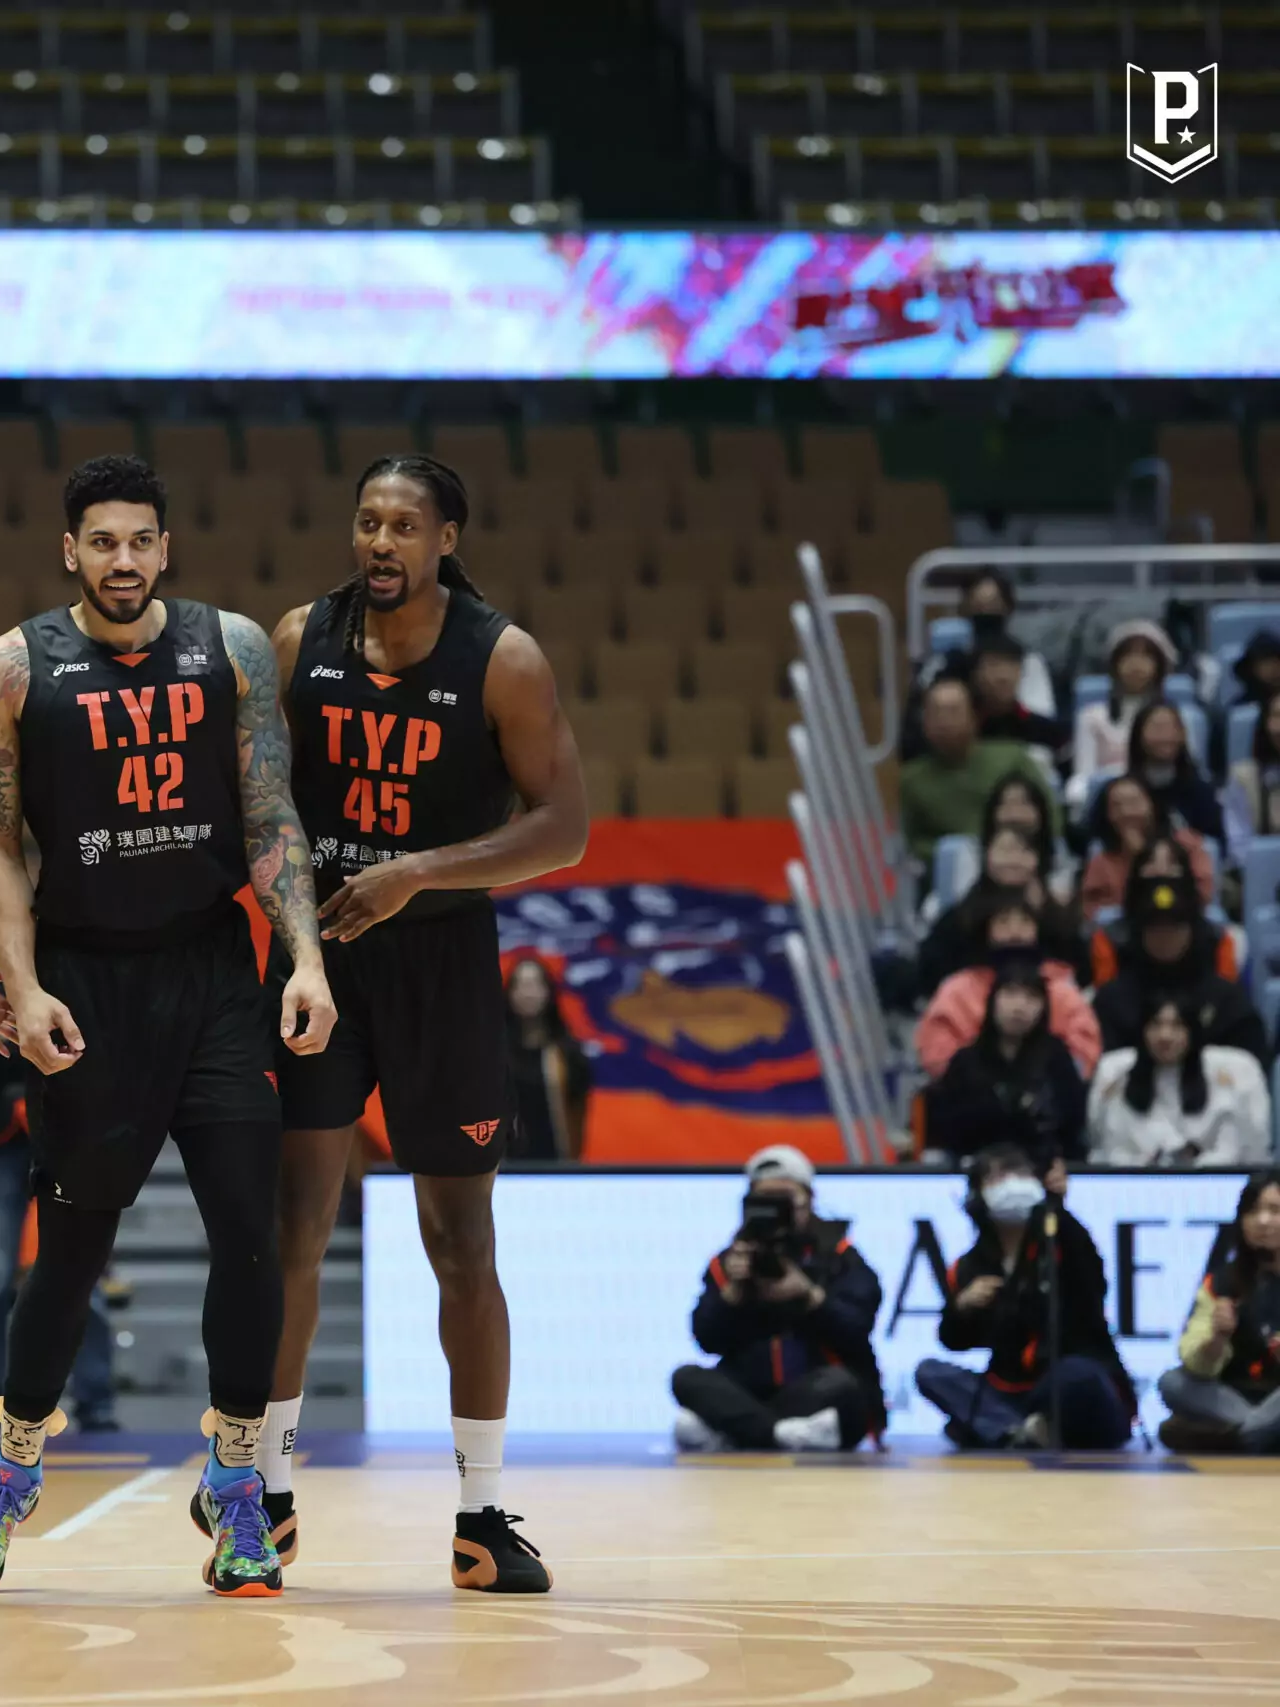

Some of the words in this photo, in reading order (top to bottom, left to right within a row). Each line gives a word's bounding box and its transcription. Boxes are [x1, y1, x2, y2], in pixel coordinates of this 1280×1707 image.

[65, 662, 90, 672] asics
[320, 668, 345, 679] asics
[76, 682, 205, 751] T.Y.P
[321, 704, 442, 776] T.Y.P
[117, 752, 185, 813] 42
[343, 776, 412, 836] 45
